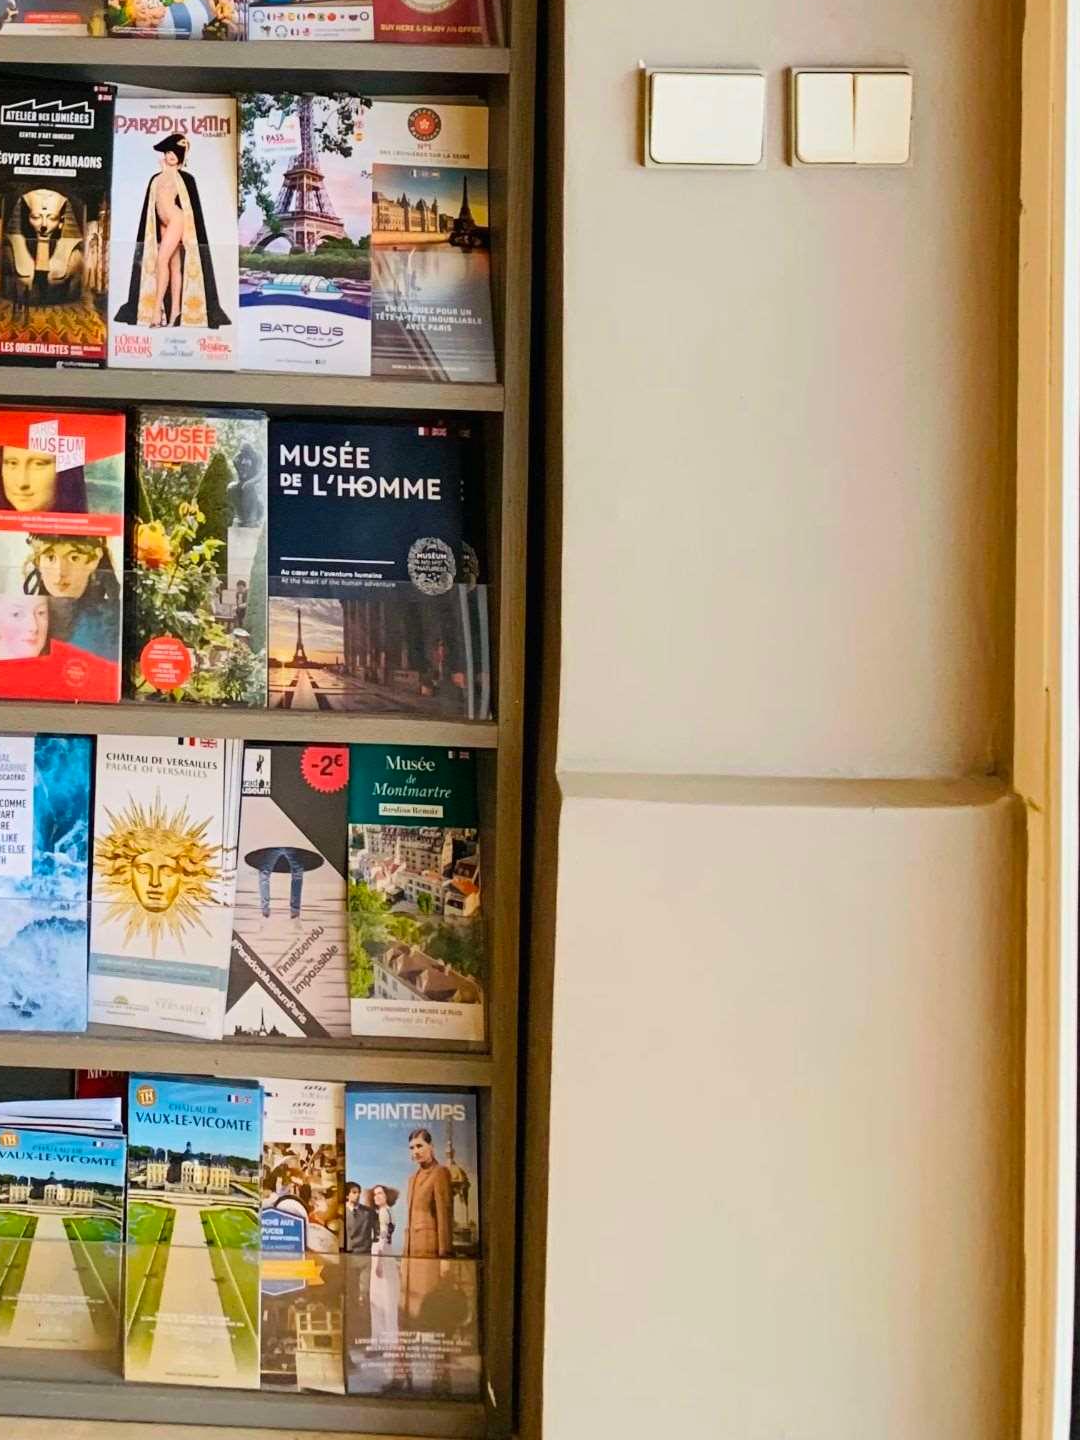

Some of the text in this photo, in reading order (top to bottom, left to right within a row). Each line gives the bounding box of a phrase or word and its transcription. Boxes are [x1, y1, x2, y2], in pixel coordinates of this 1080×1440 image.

[5, 110, 89, 124] ATELIER DES LUMIÈRES
[114, 114, 231, 135] PARADIS LATIN
[33, 154, 51, 166] DES
[53, 154, 102, 169] PHARAONS
[259, 322, 344, 337] BATOBUS
[0, 342, 14, 352] LES
[30, 437, 84, 453] MUSEUM
[145, 444, 209, 461] RODIN
[279, 440, 370, 469] MUSÉE
[280, 472, 442, 501] DE L'HOMME
[106, 752, 218, 770] CHÂTEAU DE VERSAILLES
[385, 754, 436, 771] Musée
[105, 762, 208, 779] PALACE OF VERSAILLES
[405, 774, 417, 785] de
[372, 782, 452, 799] Montmartre
[0, 799, 27, 809] COMME
[2, 833, 18, 842] LIKE
[7, 844, 25, 854] ELSE
[354, 1102, 467, 1121] PRINTEMPS
[135, 1111, 253, 1132] VAUX-LE-VICOMTE
